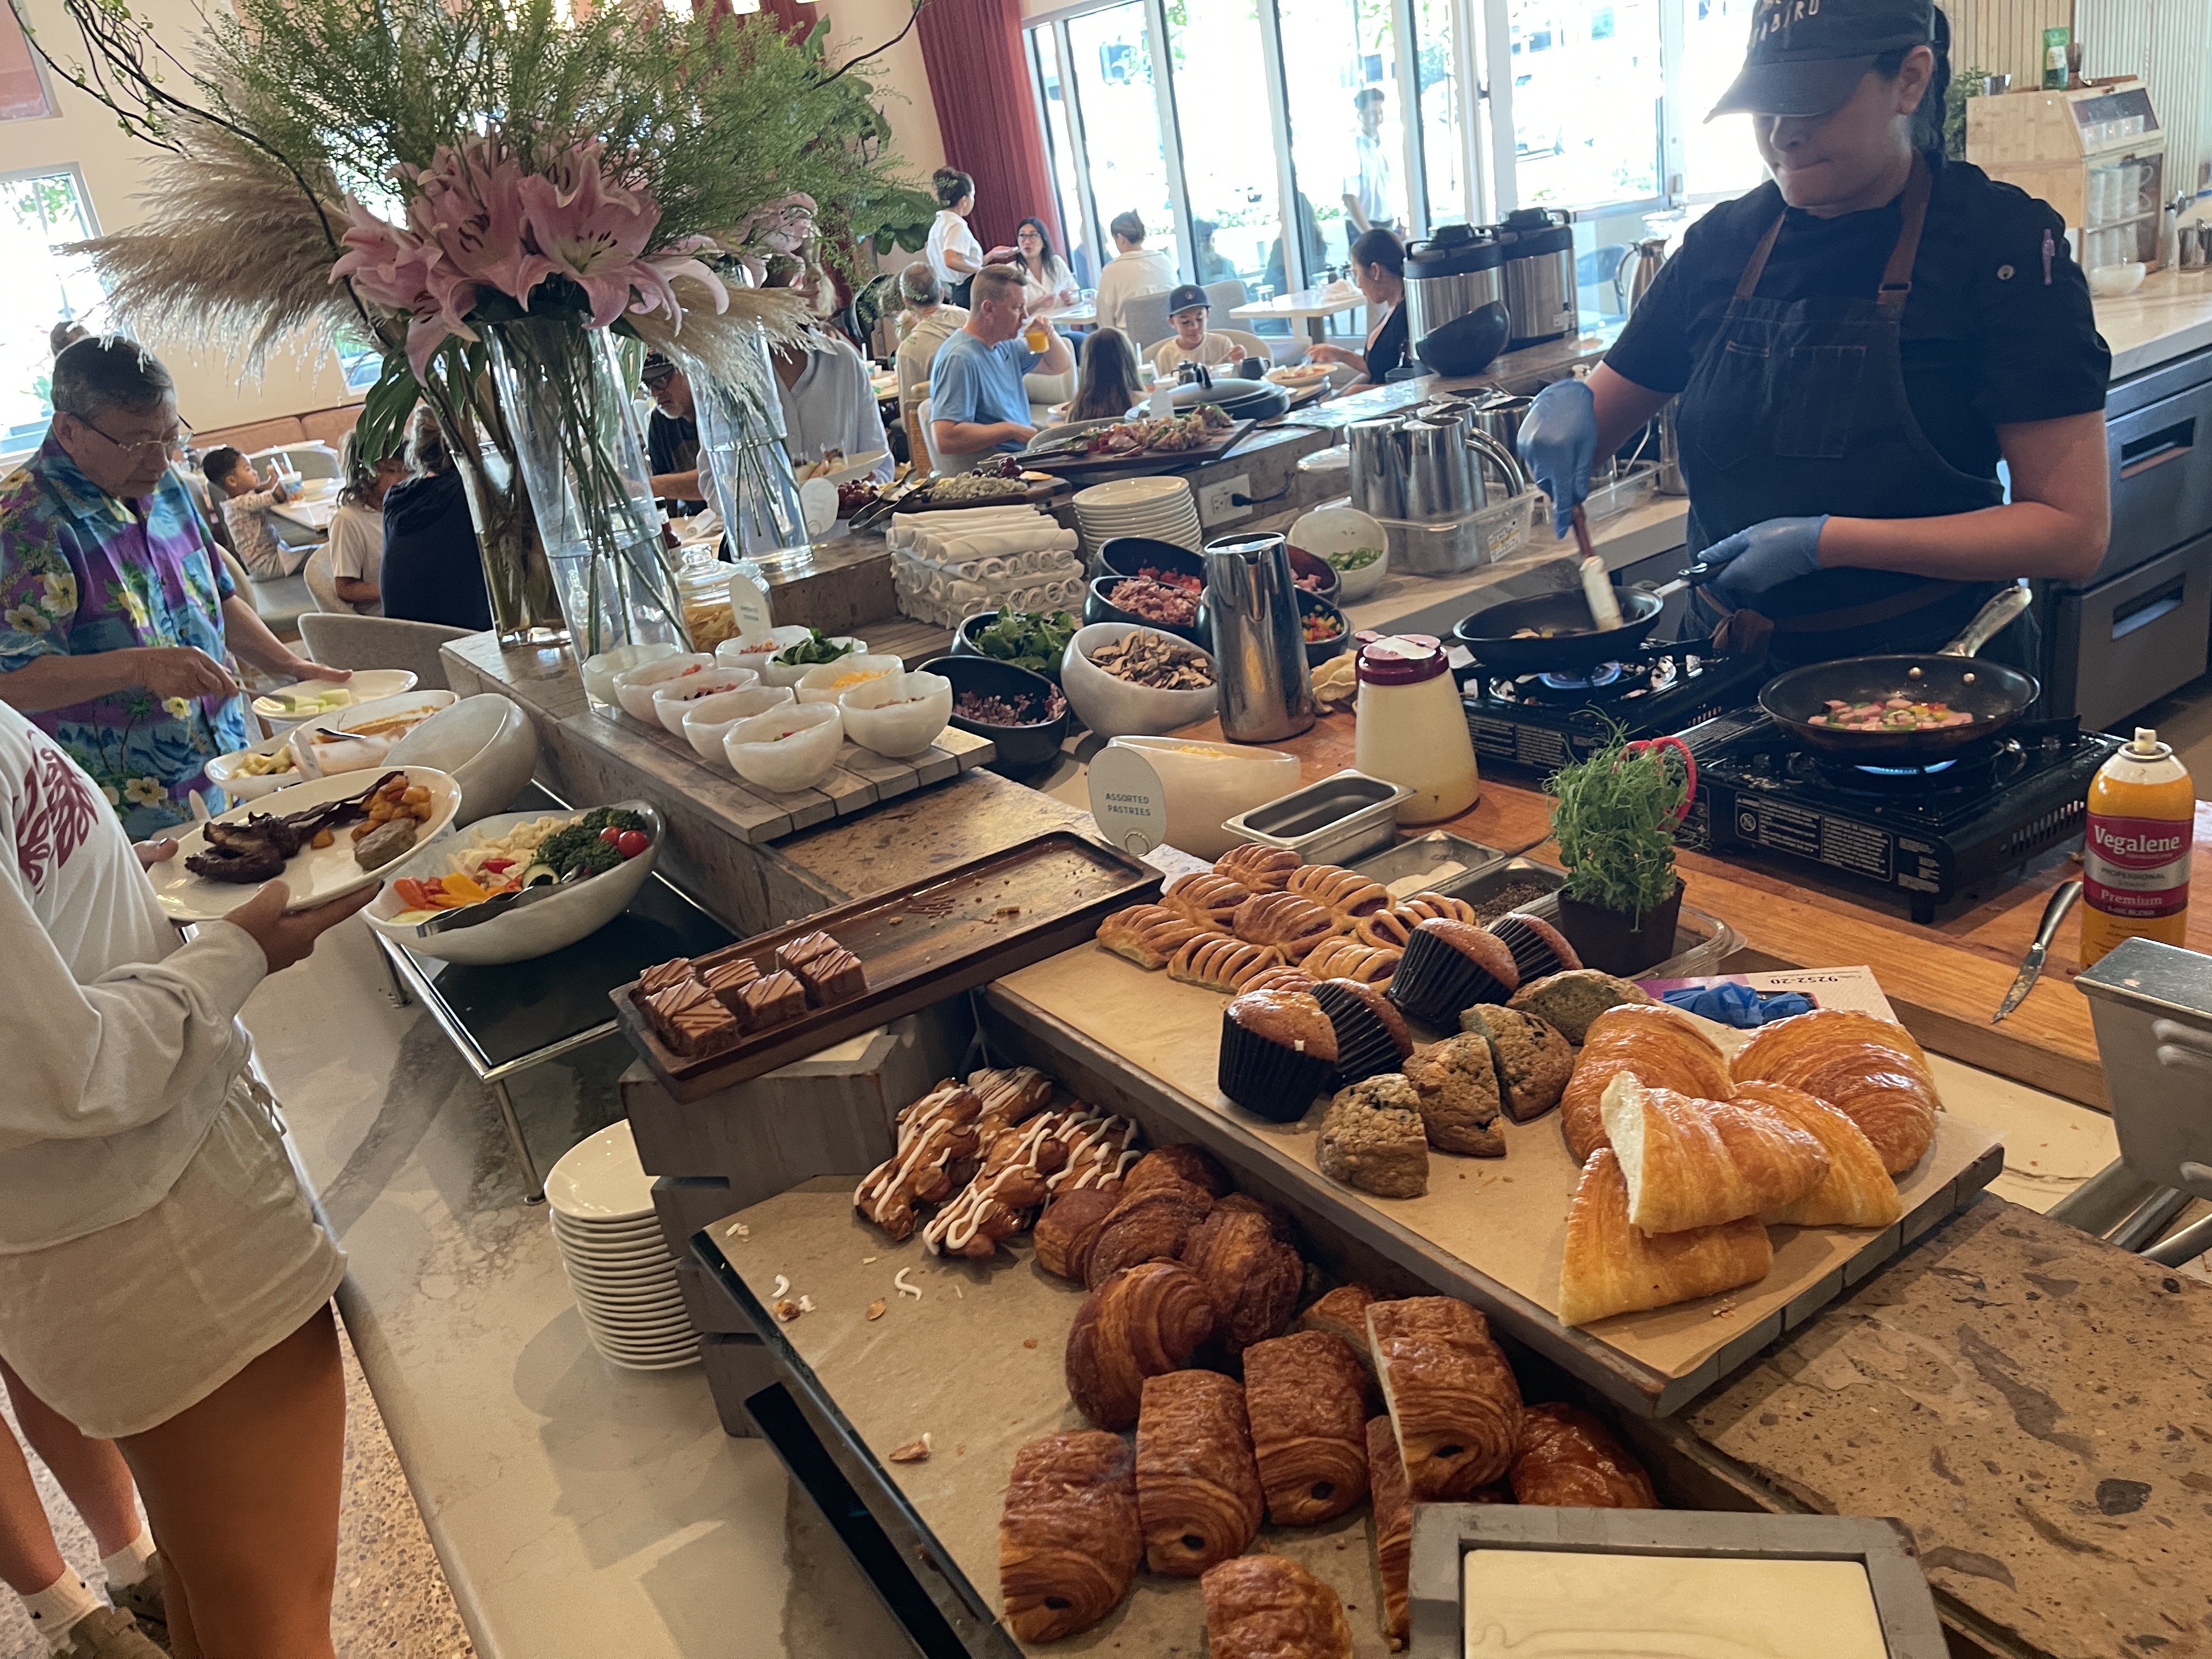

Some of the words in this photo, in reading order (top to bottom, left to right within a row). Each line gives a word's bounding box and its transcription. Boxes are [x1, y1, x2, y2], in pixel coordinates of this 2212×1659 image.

[1106, 793, 1149, 804] ASSORTED
[1108, 805, 1151, 816] PASTRIES
[2094, 825, 2180, 855] Vegalene
[2101, 889, 2163, 905] Premium
[1770, 976, 1838, 985] 9252-20
